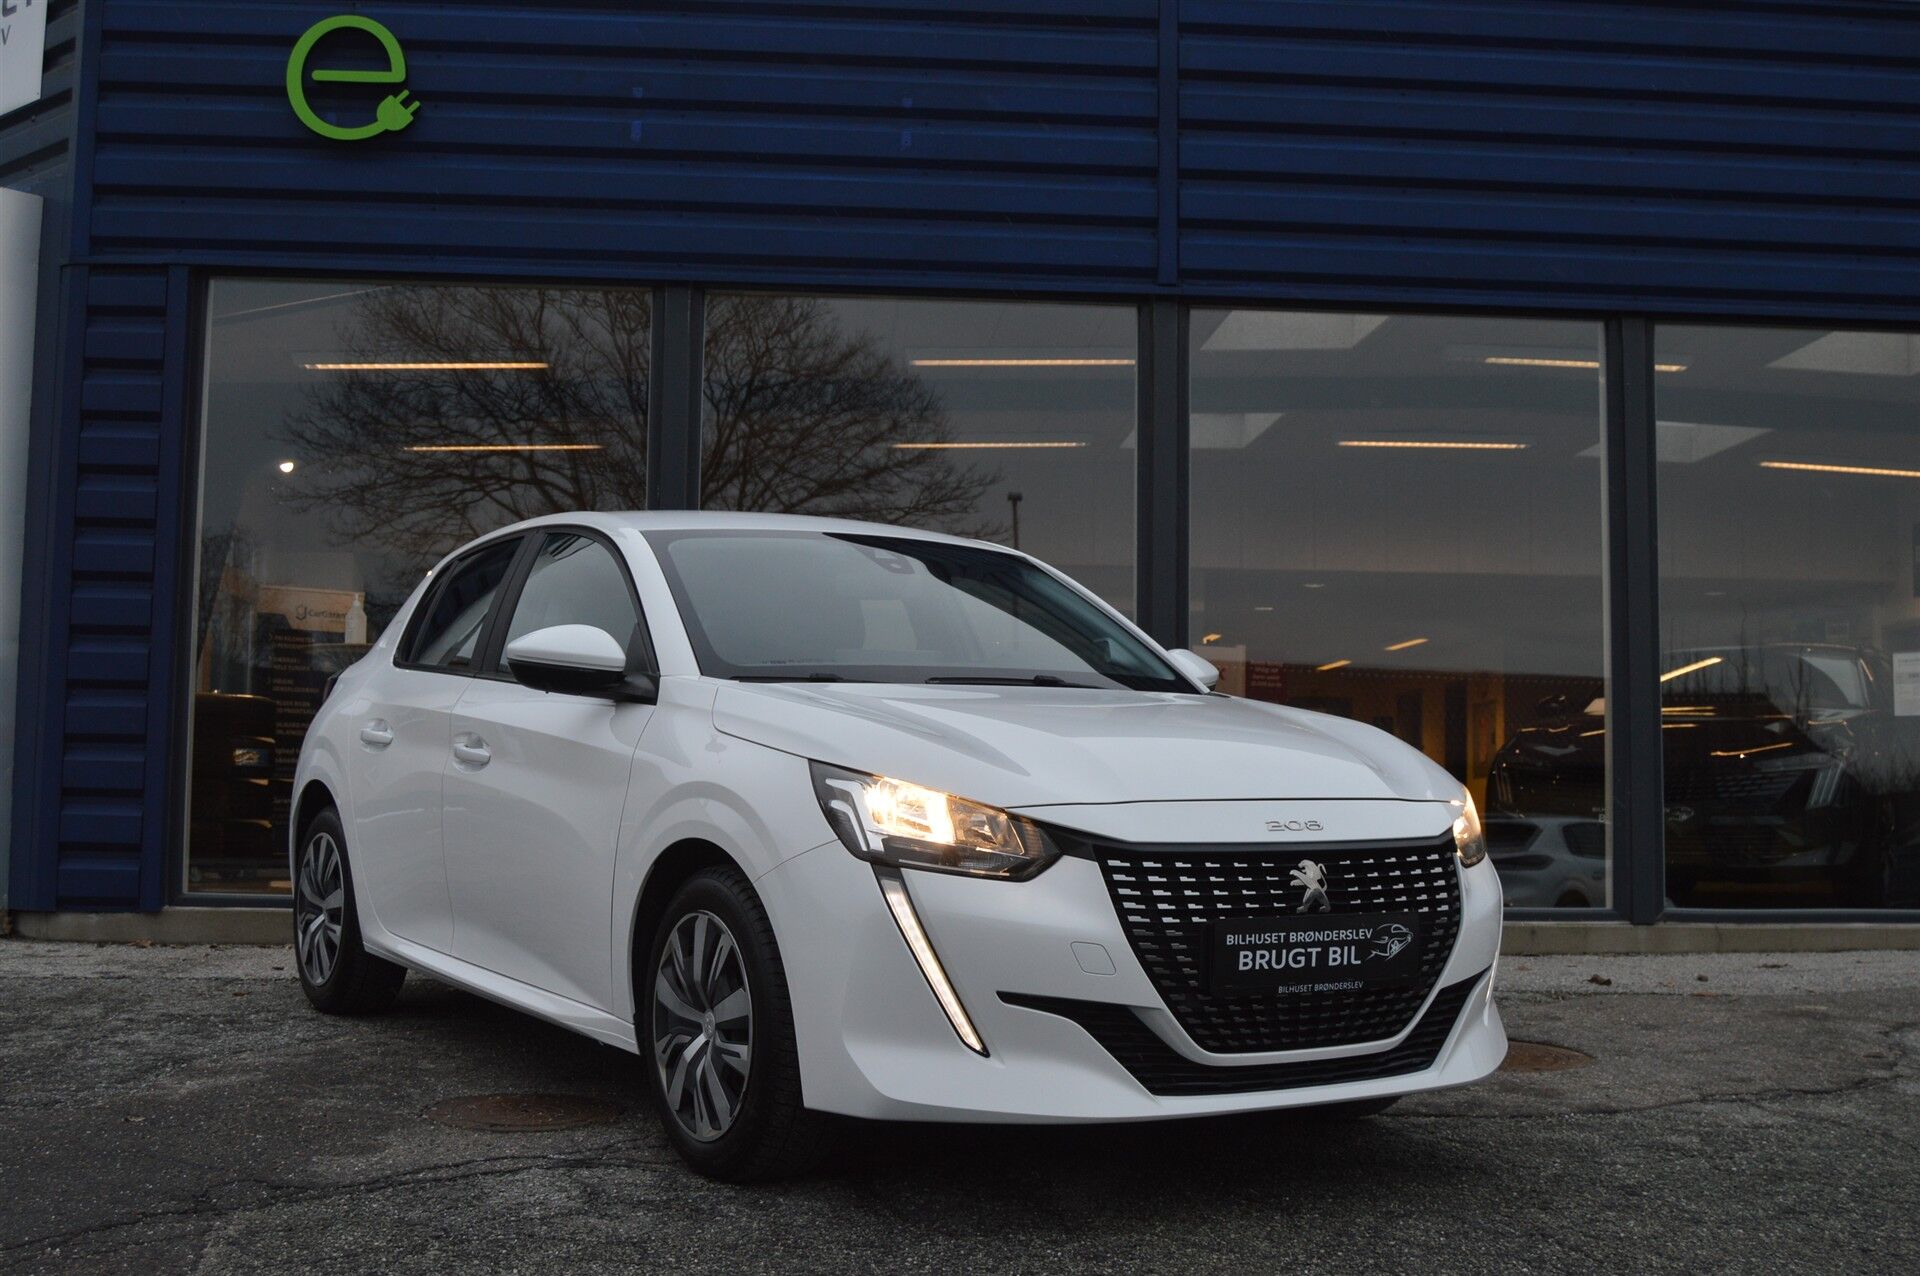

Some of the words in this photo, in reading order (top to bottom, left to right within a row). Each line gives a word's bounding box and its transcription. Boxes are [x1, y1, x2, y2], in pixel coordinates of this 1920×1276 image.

[1265, 820, 1324, 831] 208
[1226, 932, 1286, 945] BILHUSET
[1289, 928, 1373, 943] BRØNDERSLEV
[1238, 947, 1321, 971] BRUGT
[1328, 945, 1361, 966] BIL
[1278, 984, 1312, 994] BILHUSET
[1314, 981, 1363, 992] BRØNDERSLEV
